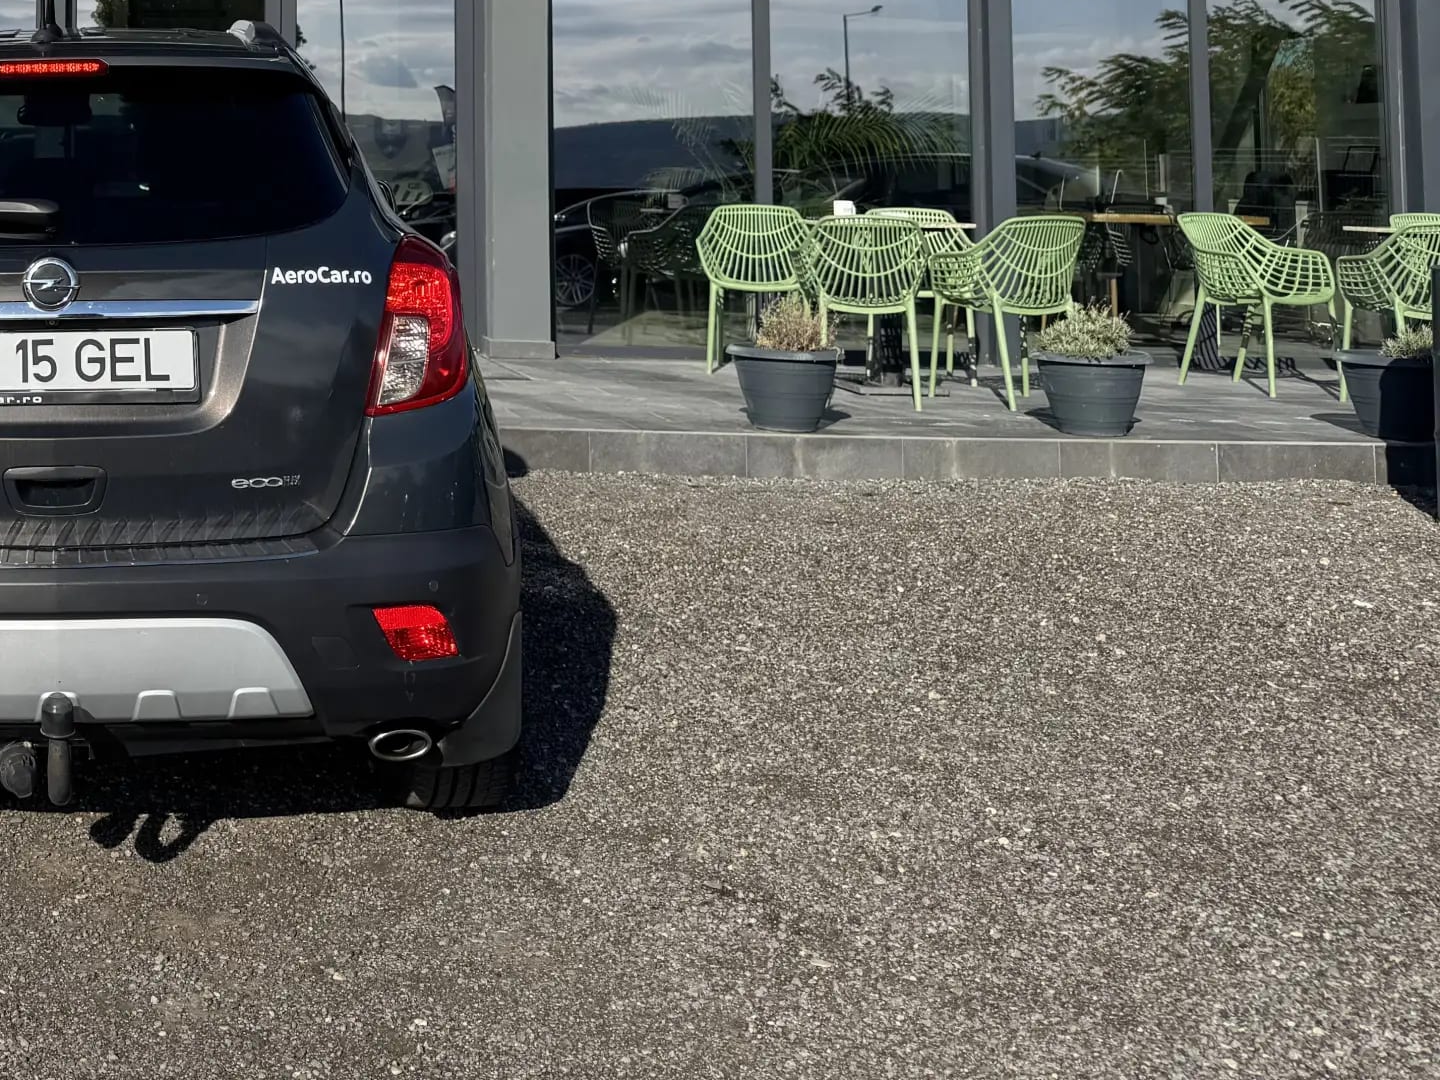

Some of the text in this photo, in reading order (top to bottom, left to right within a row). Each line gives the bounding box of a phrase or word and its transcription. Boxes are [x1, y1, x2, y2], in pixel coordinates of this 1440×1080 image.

[271, 266, 372, 285] AeroCar.ro
[15, 338, 58, 383] 15
[74, 337, 171, 383] GEL
